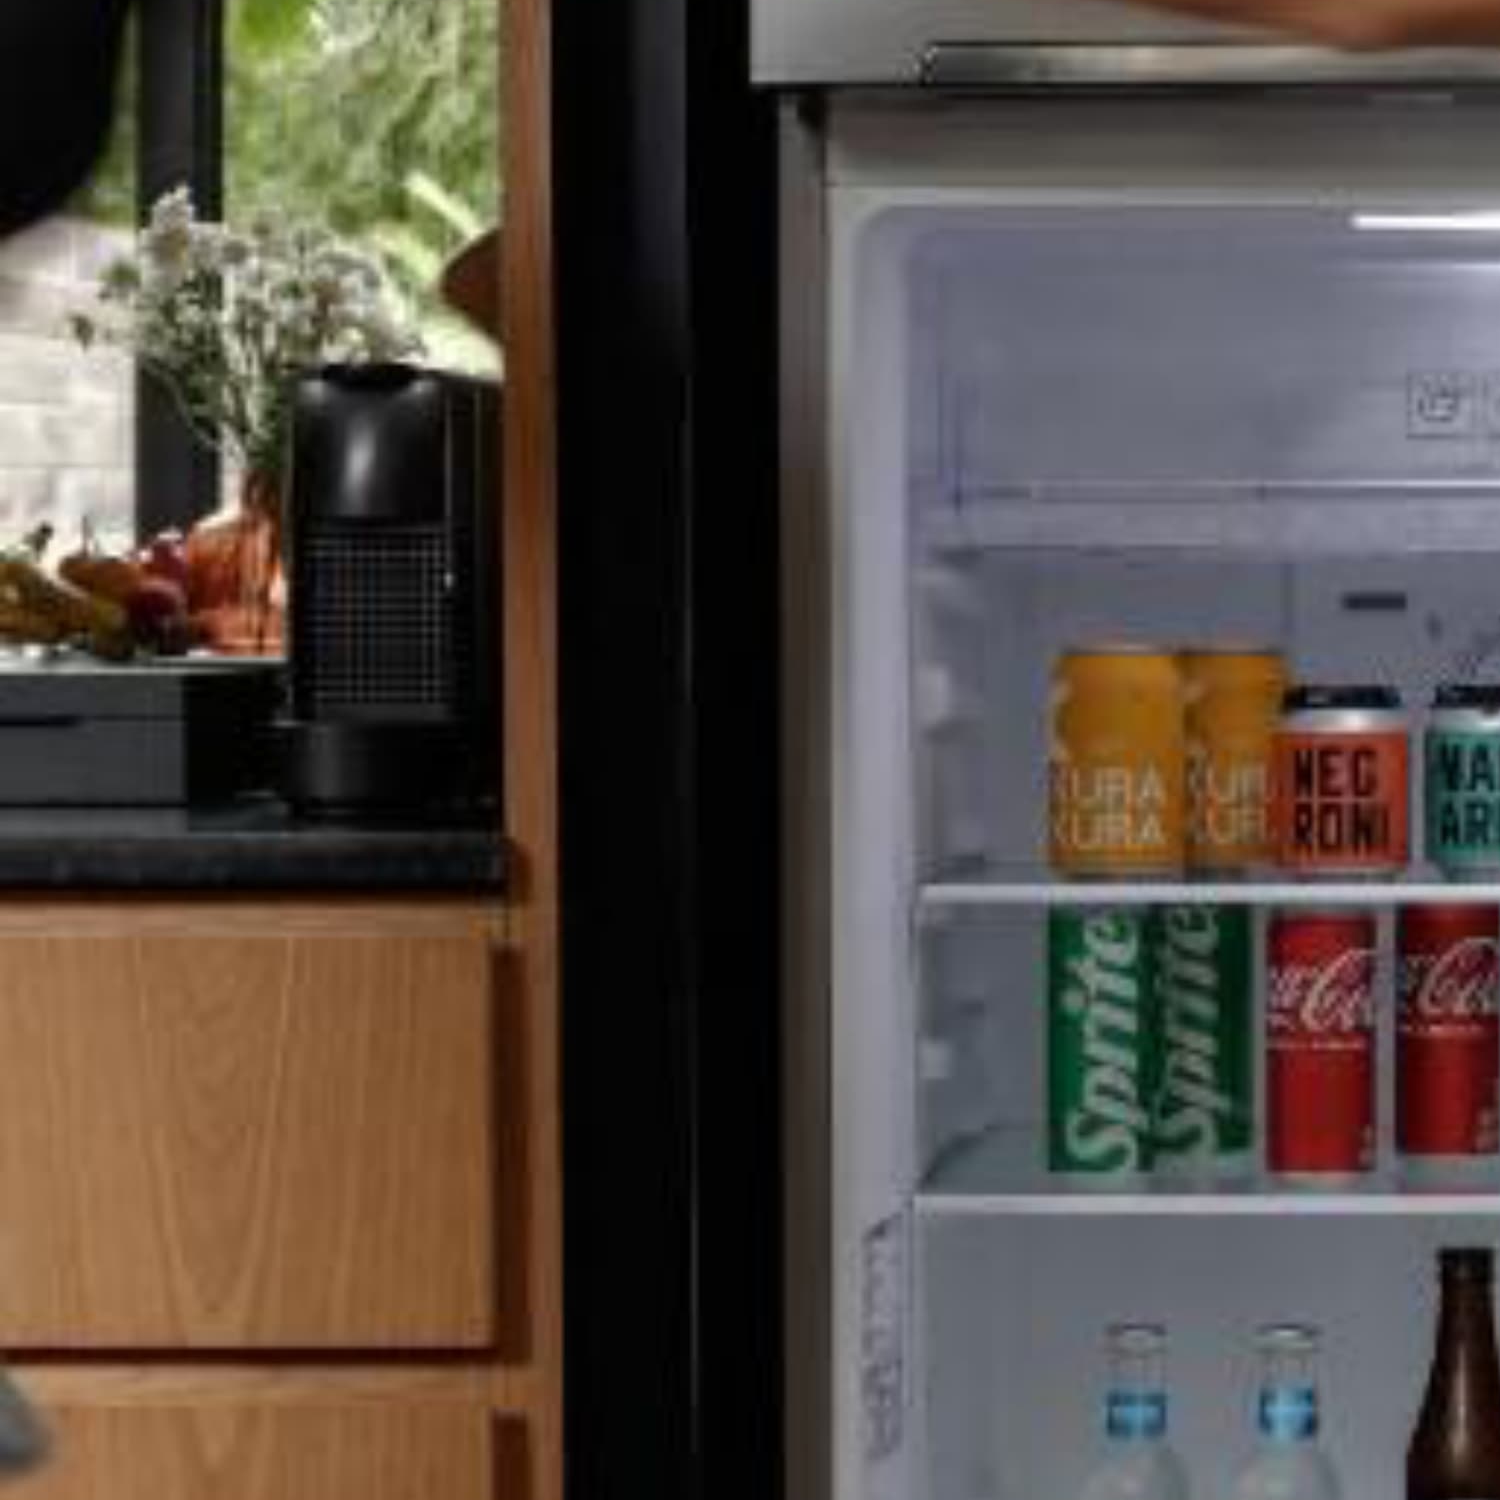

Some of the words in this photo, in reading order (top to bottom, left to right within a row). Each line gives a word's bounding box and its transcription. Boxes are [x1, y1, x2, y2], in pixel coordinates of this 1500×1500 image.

[1293, 802, 1390, 851] RONI
[1061, 912, 1148, 1175] Sprite
[1151, 903, 1230, 1168] Sprite
